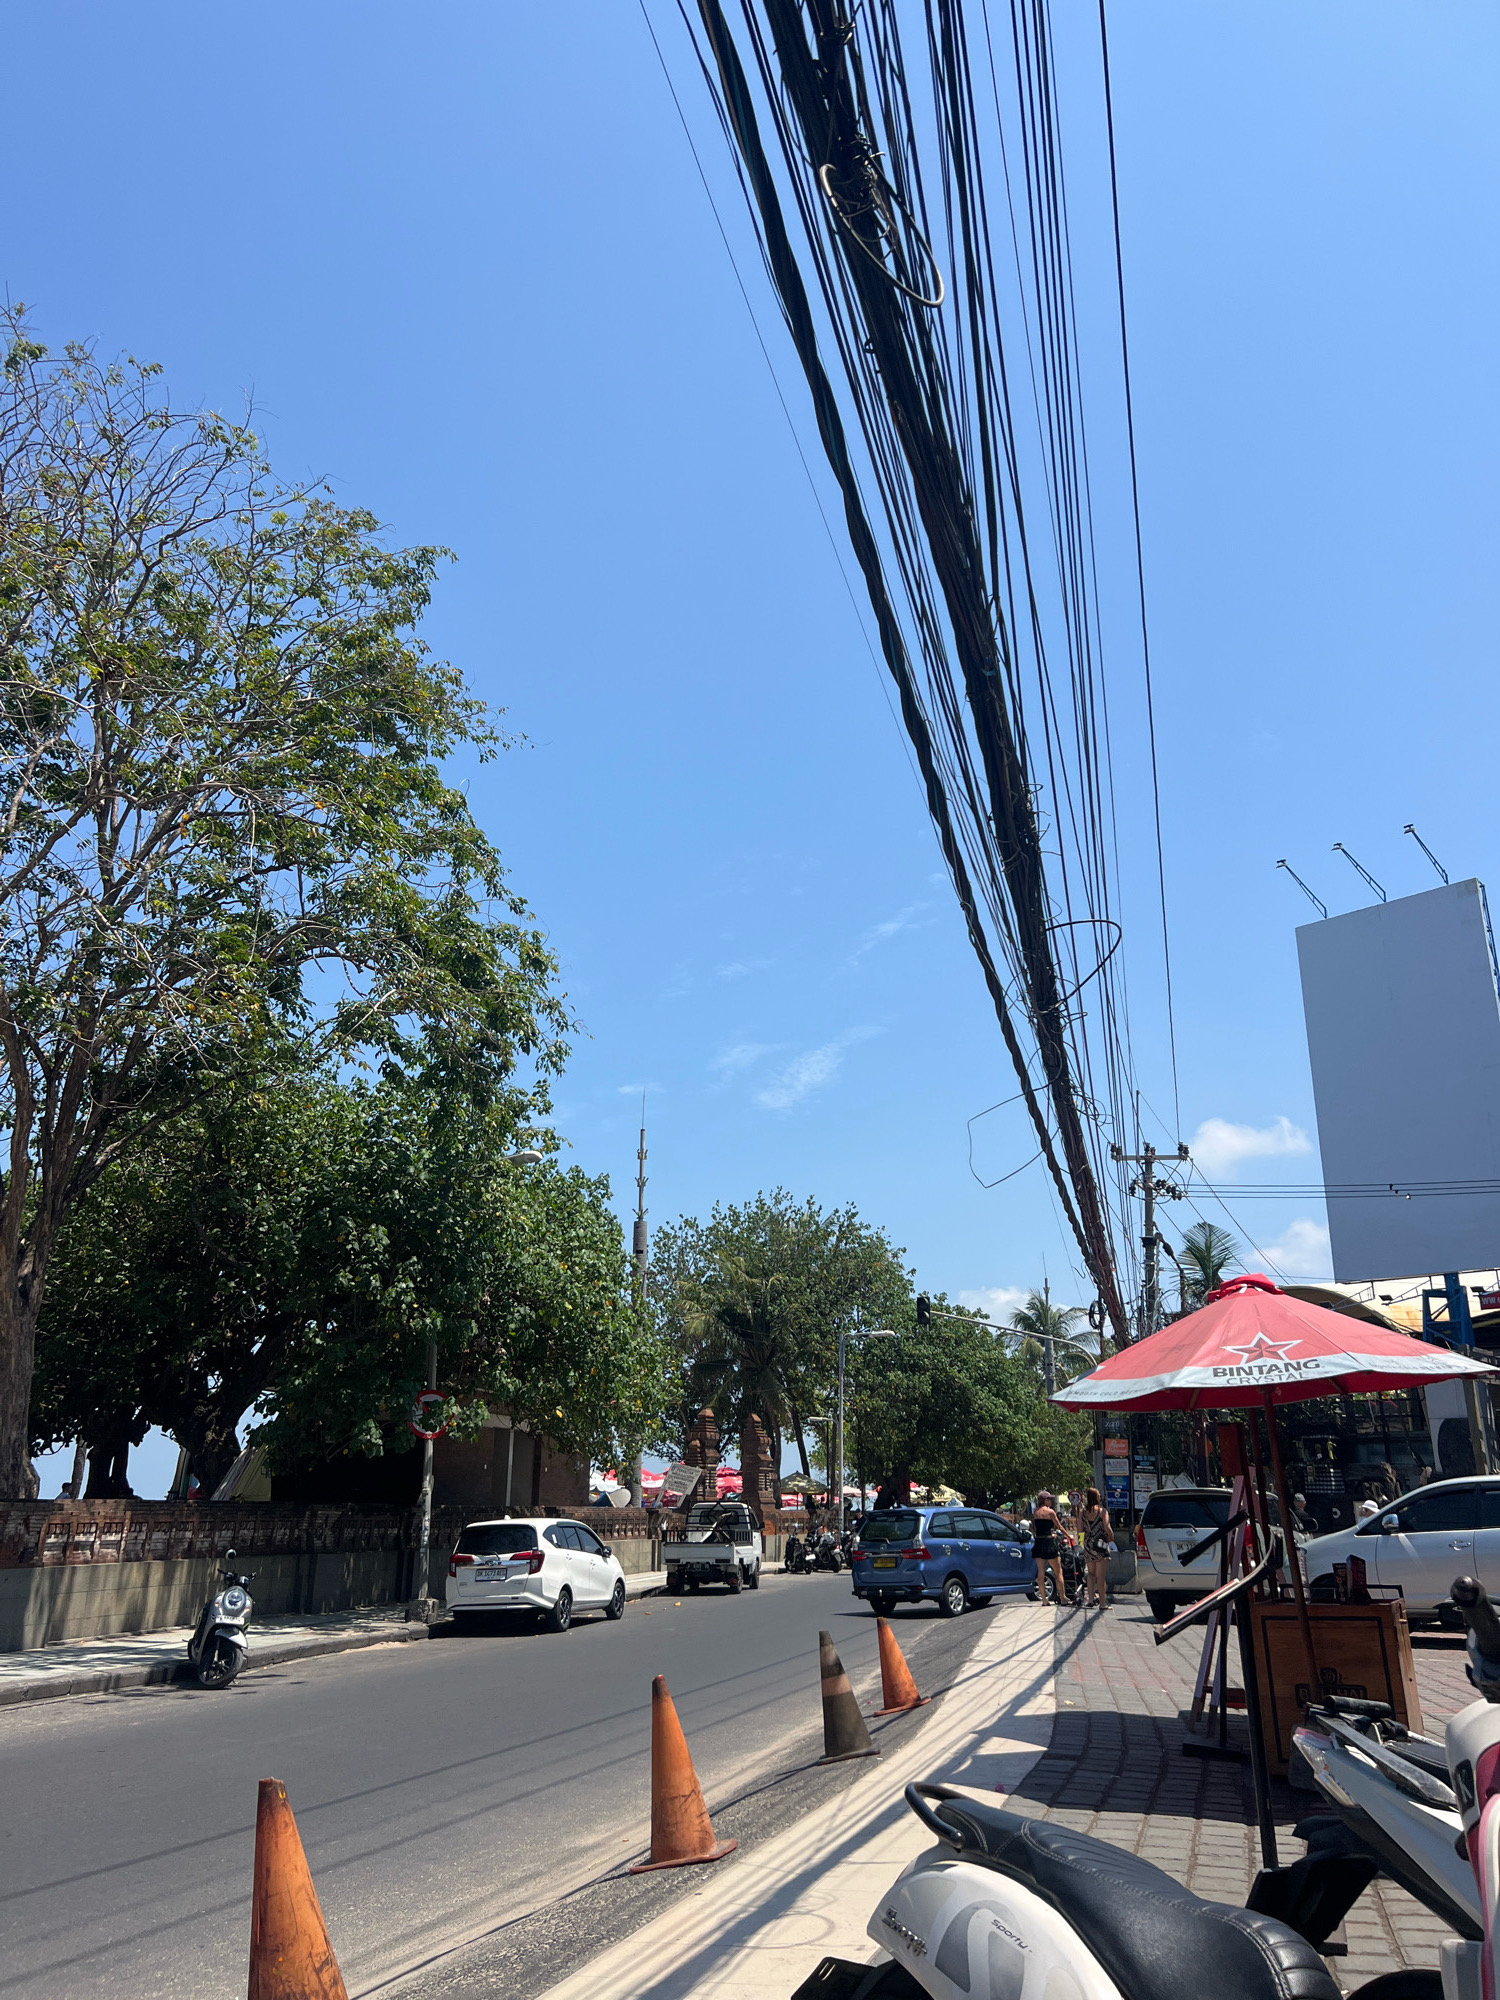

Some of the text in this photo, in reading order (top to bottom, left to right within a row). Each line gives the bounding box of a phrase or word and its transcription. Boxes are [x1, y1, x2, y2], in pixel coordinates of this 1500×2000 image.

[1212, 1359, 1321, 1378] BINTANG
[1226, 1371, 1310, 1385] CRYSTAL
[990, 1919, 1029, 1950] Sporty
